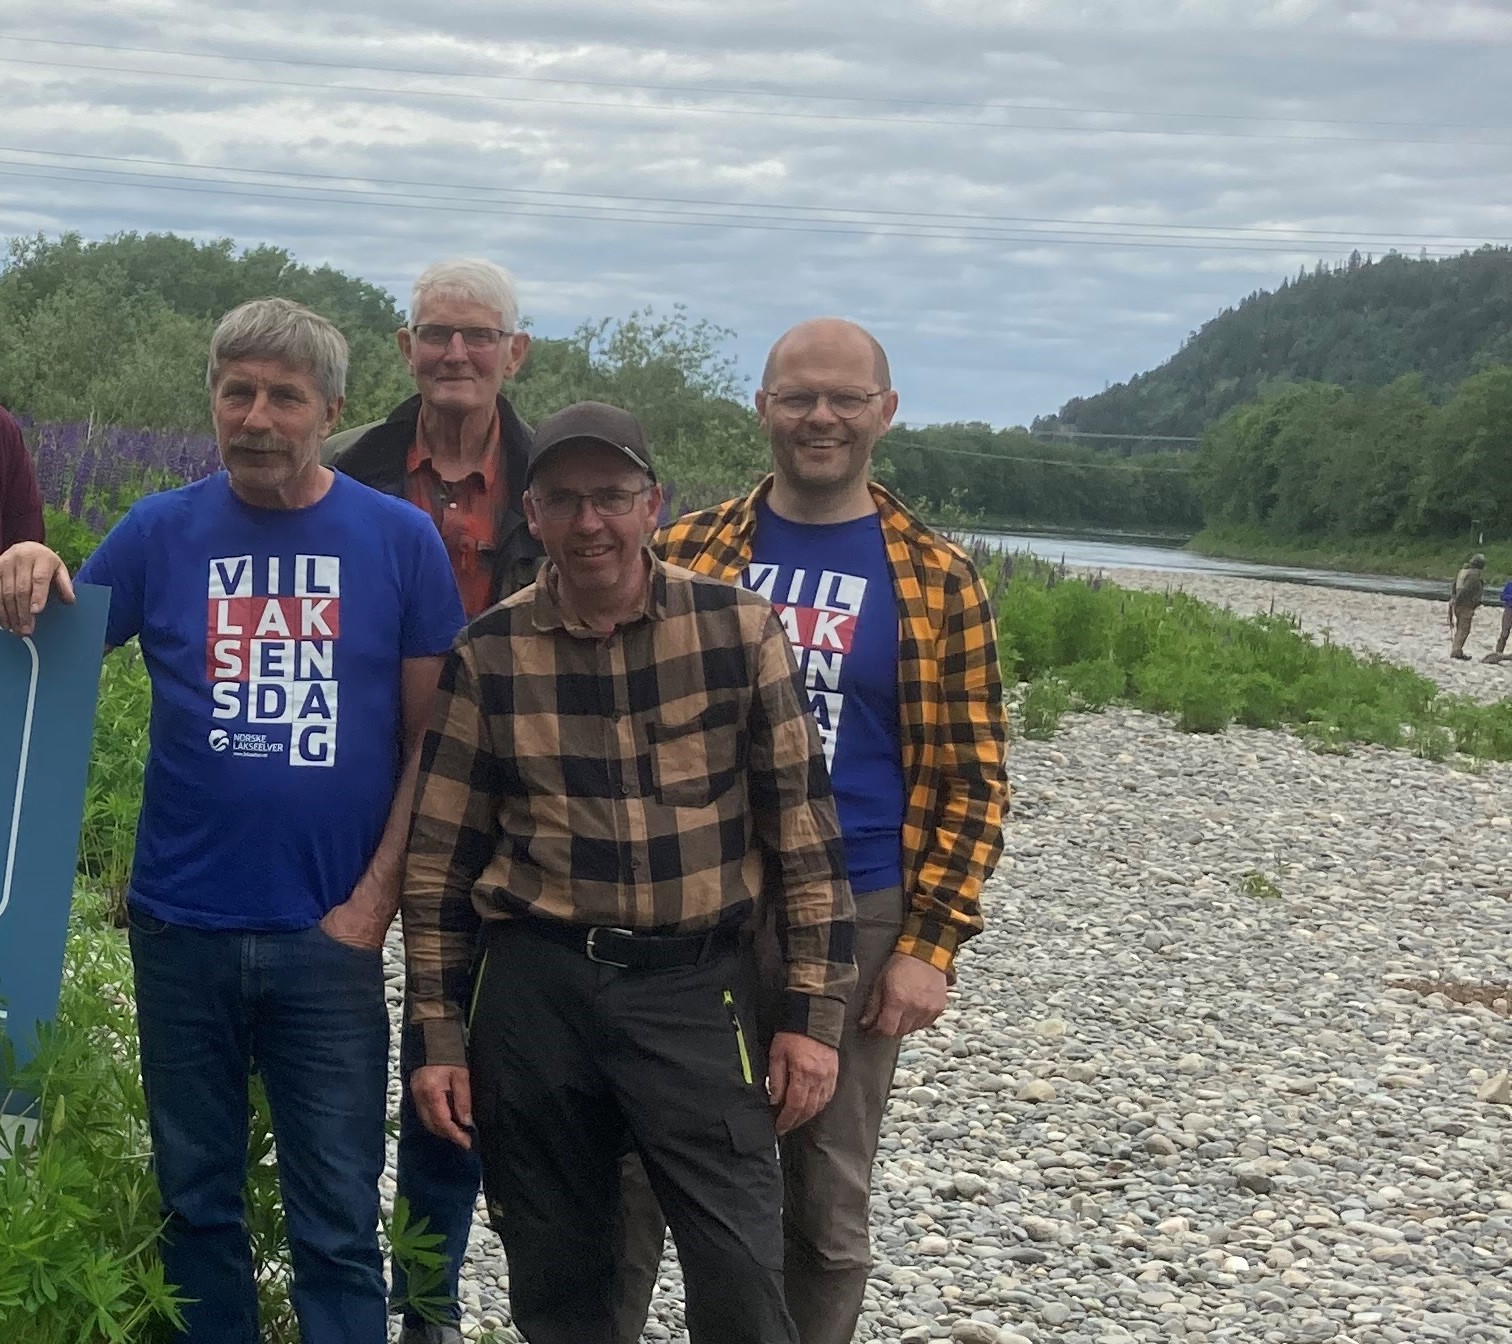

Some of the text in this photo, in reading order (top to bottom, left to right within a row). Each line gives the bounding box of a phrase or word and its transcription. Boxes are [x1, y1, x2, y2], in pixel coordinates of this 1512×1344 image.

[215, 557, 331, 596] VIL
[217, 599, 333, 636] LAK
[213, 639, 333, 678] SEN
[233, 733, 267, 743] NORSKE
[233, 742, 284, 752] LAKSEELVER
